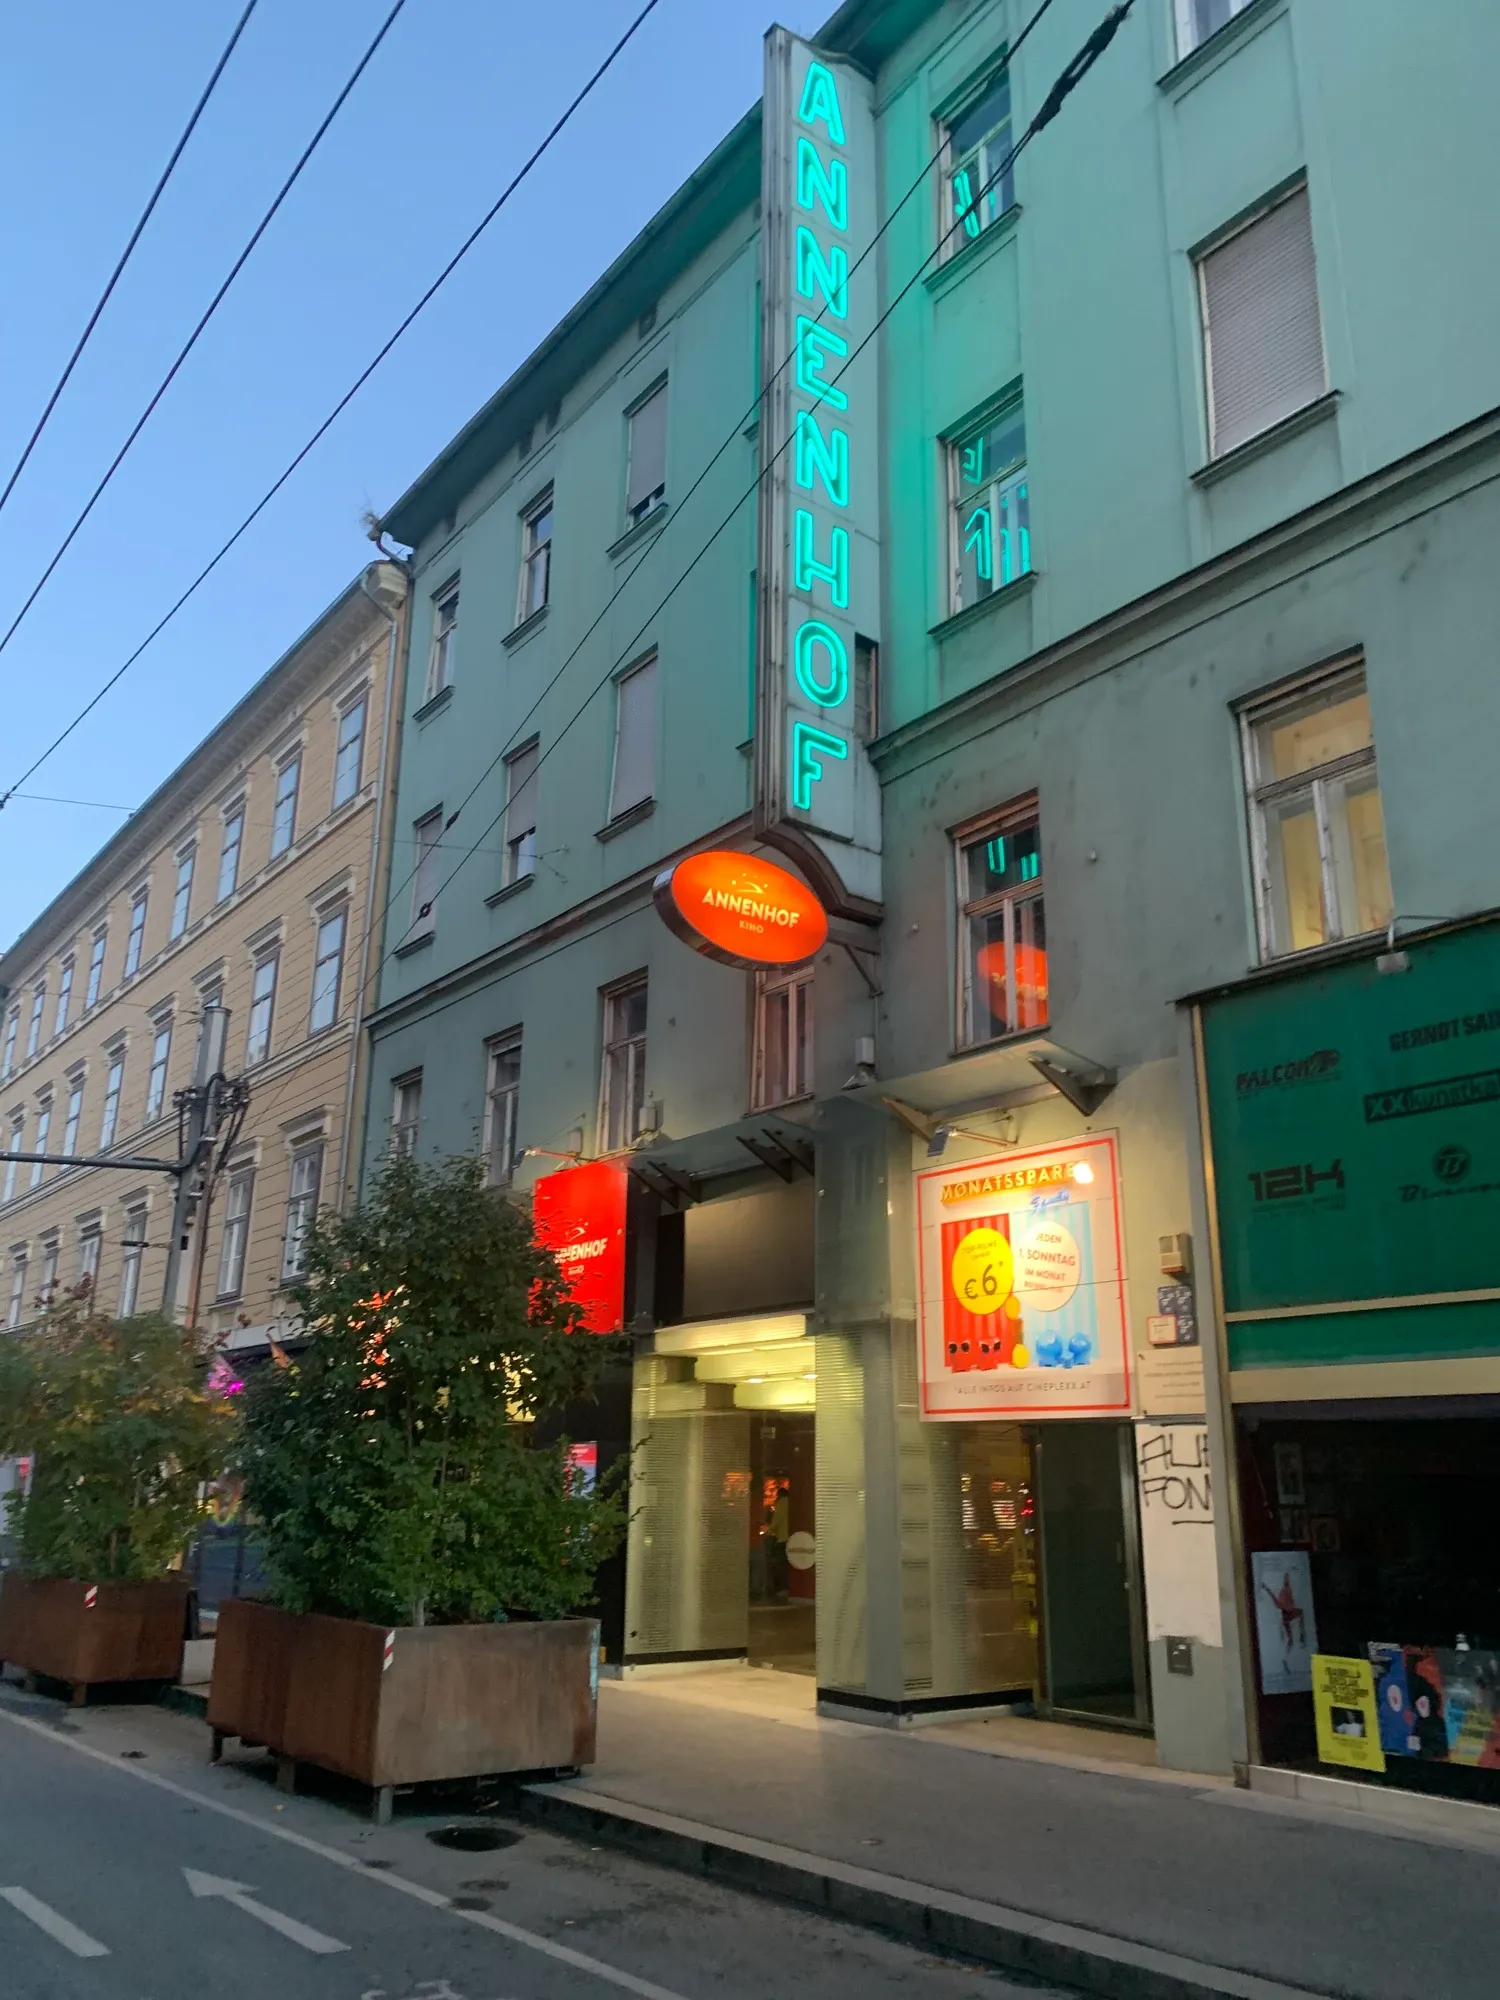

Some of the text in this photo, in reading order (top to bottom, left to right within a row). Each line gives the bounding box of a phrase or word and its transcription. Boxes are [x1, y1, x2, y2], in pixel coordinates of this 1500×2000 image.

[793, 61, 849, 810] ANNENHOF
[701, 887, 800, 928] ANNENHOF
[739, 920, 765, 934] KINO
[941, 1163, 1088, 1201] MONATSSPARE
[1247, 1158, 1345, 1202] 12H
[1036, 1233, 1062, 1244] JEDEN
[1027, 1249, 1076, 1266] SONNTAG
[1025, 1268, 1066, 1282] IM MONAT
